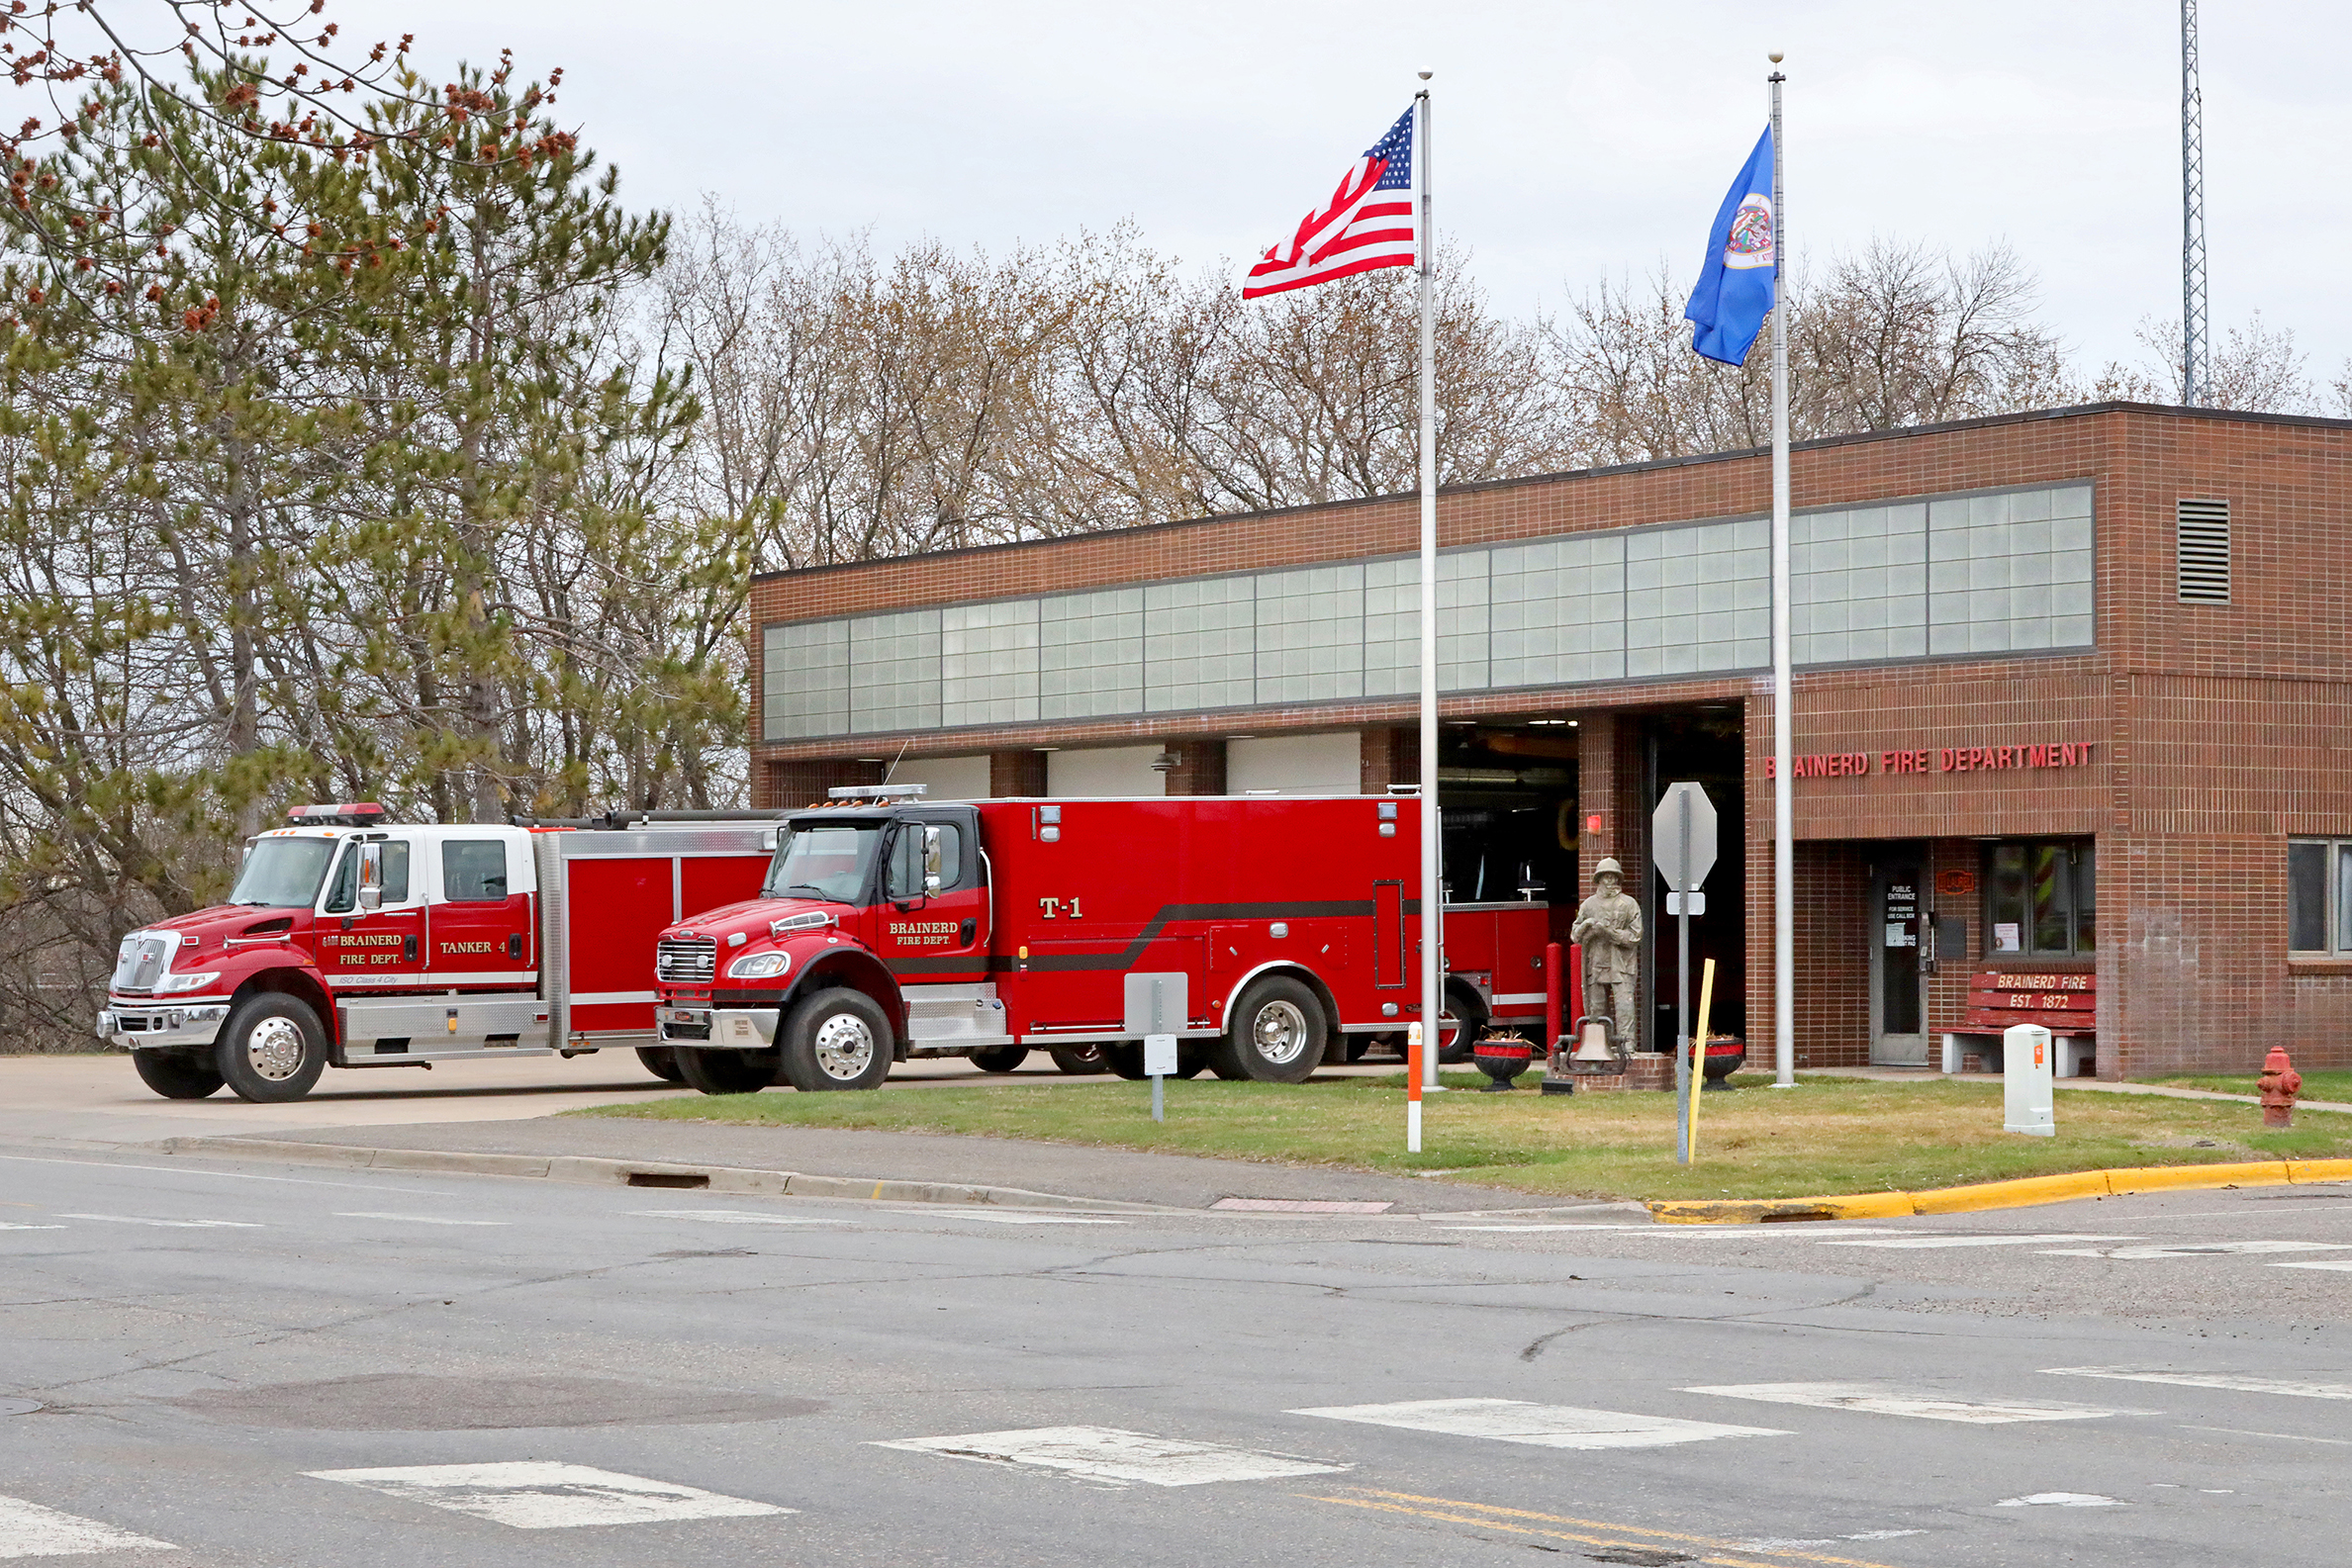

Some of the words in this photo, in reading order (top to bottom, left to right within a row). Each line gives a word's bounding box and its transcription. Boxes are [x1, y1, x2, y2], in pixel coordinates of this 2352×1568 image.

[1764, 752, 1869, 779] BAINERD
[1880, 749, 1928, 774] FIRE
[1940, 742, 2092, 772] DEPARTMENT
[1040, 897, 1082, 918] T-1
[890, 922, 958, 934] BRAINERD
[339, 935, 402, 947] BRAINERD
[896, 936, 921, 945] FIRE
[923, 936, 951, 945] DEPT.
[439, 942, 492, 954] TANKER
[498, 942, 506, 953] 4
[339, 955, 365, 965] FIRE
[370, 955, 401, 965] DEPT.
[384, 975, 399, 984] City
[1997, 975, 2056, 988] BRAINERD
[2061, 975, 2087, 989] FIRE
[2010, 994, 2034, 1008] EST.
[2041, 994, 2069, 1008] 1872
